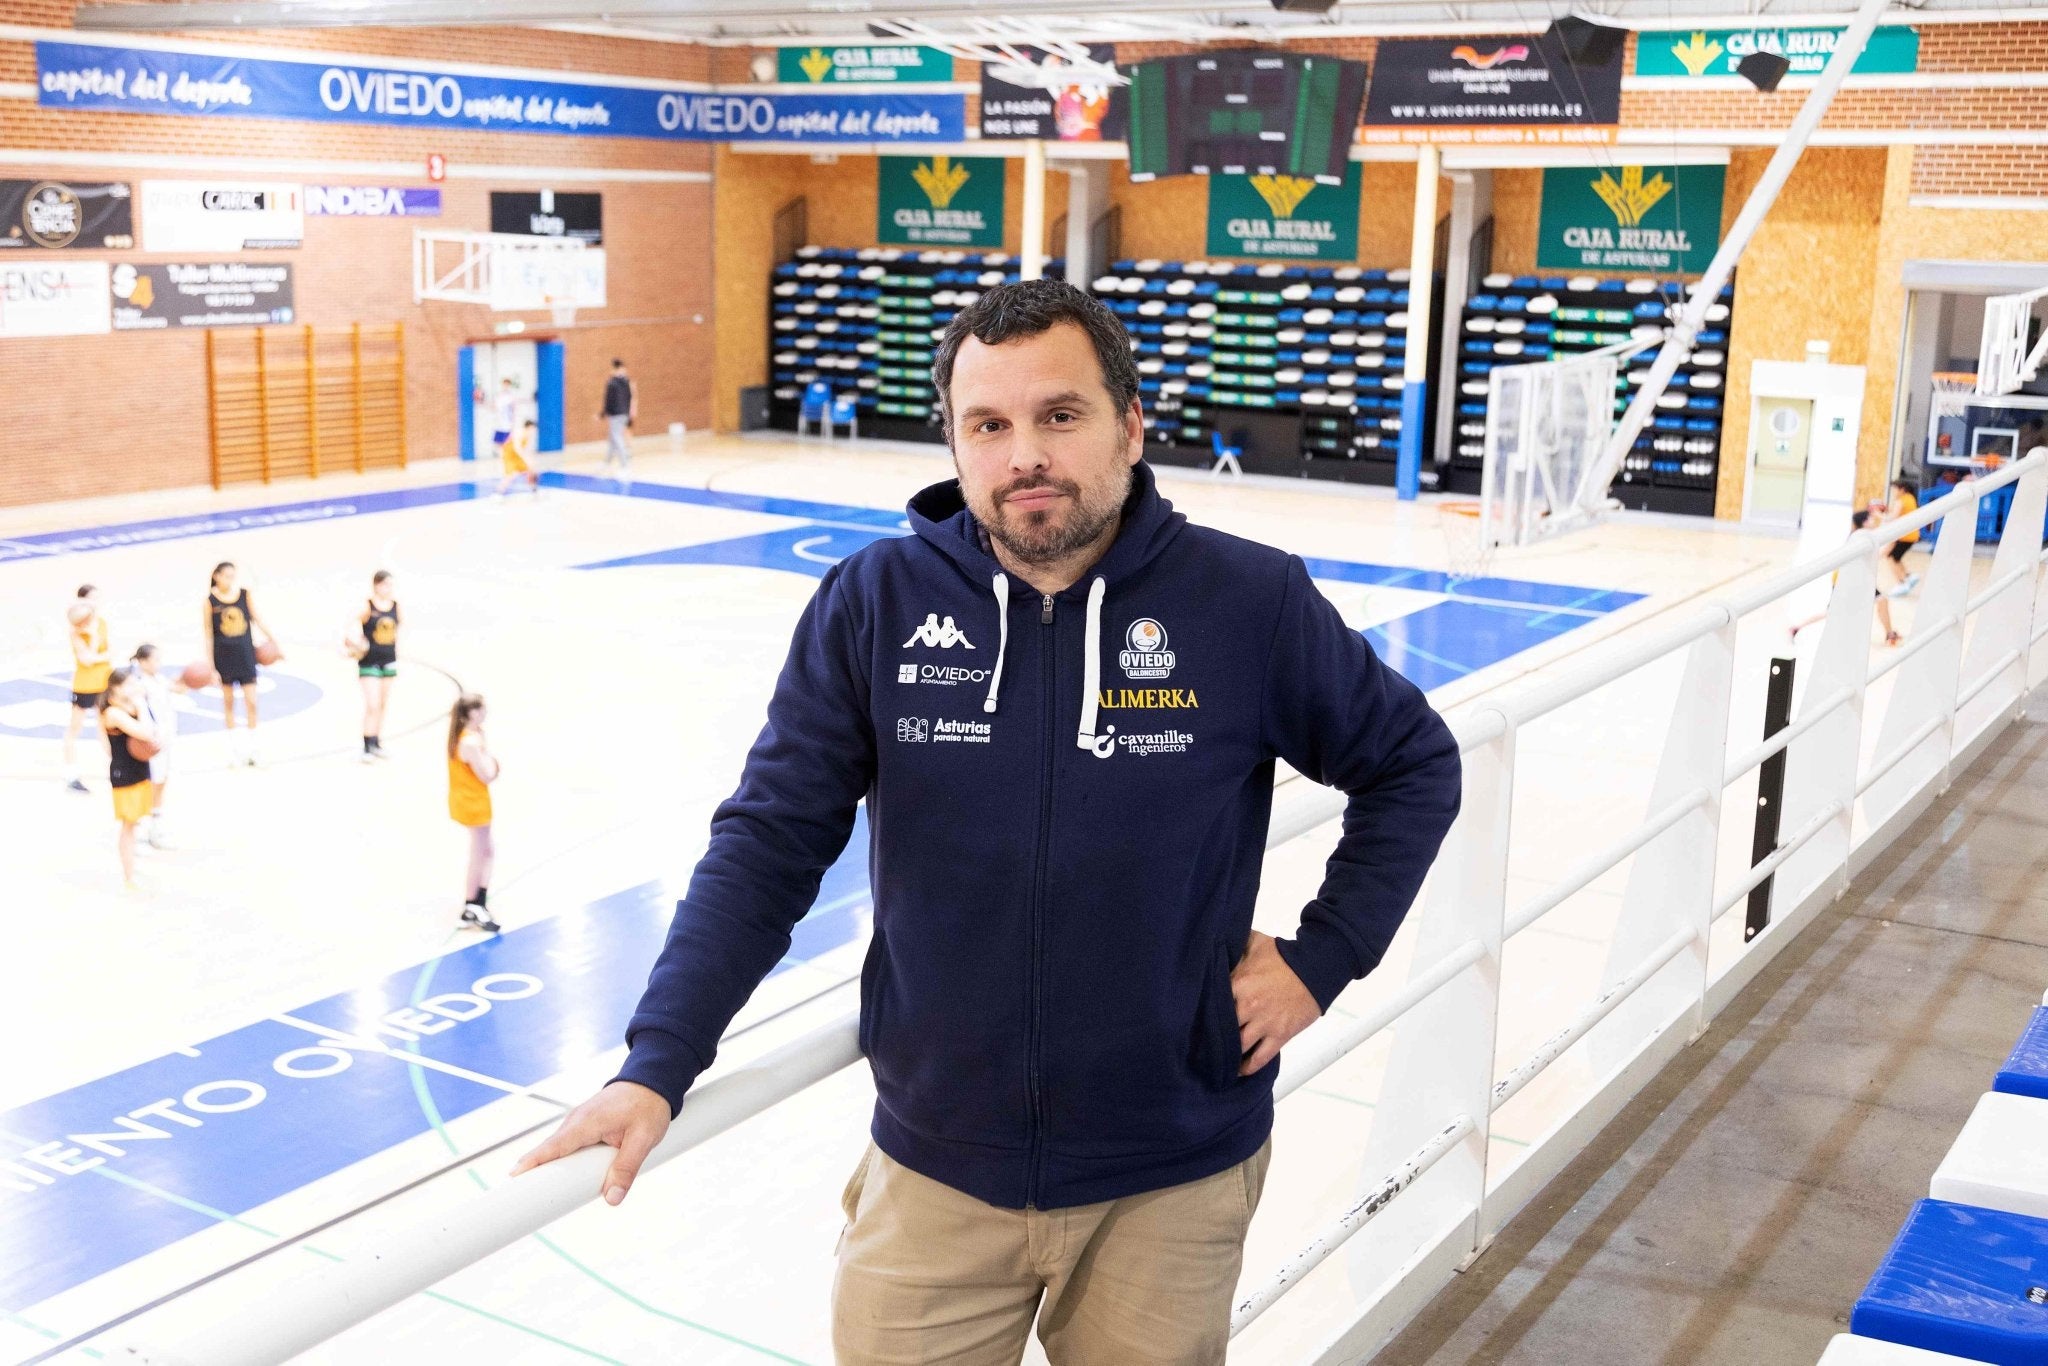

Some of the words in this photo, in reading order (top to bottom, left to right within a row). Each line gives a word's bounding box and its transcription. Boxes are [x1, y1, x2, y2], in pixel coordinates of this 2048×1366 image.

[1726, 33, 1783, 54] CAJA
[130, 67, 168, 102] del
[171, 71, 253, 109] deporte
[319, 68, 462, 118] OVIEDO
[524, 95, 553, 124] del
[656, 94, 776, 133] OVIEDO
[839, 109, 871, 135] del
[984, 101, 1003, 115] LA
[1390, 103, 1583, 118] WWW.UNIONFINANCIERA.ES
[984, 119, 1012, 134] NOS
[1012, 119, 1039, 134] UNE
[304, 187, 405, 216] INDIBA
[894, 208, 931, 228] CAJA
[933, 209, 986, 230] RURAL
[1227, 218, 1271, 239] CAJA
[1274, 220, 1336, 241] RURAL
[1562, 227, 1614, 249] CAJA
[1618, 229, 1692, 251] RURAL
[1581, 250, 1600, 264] DE
[1602, 252, 1670, 267] ASTURIAS
[1121, 652, 1173, 667] OVIEDO
[1129, 668, 1167, 677] BALONCESTO
[920, 678, 957, 686] AYUNTAMIENTO
[933, 718, 991, 734] Asturias
[963, 734, 991, 743] natural
[1118, 730, 1194, 745] cavanilles
[1128, 742, 1187, 756] ingenieros
[273, 972, 544, 1079] OVIEDO
